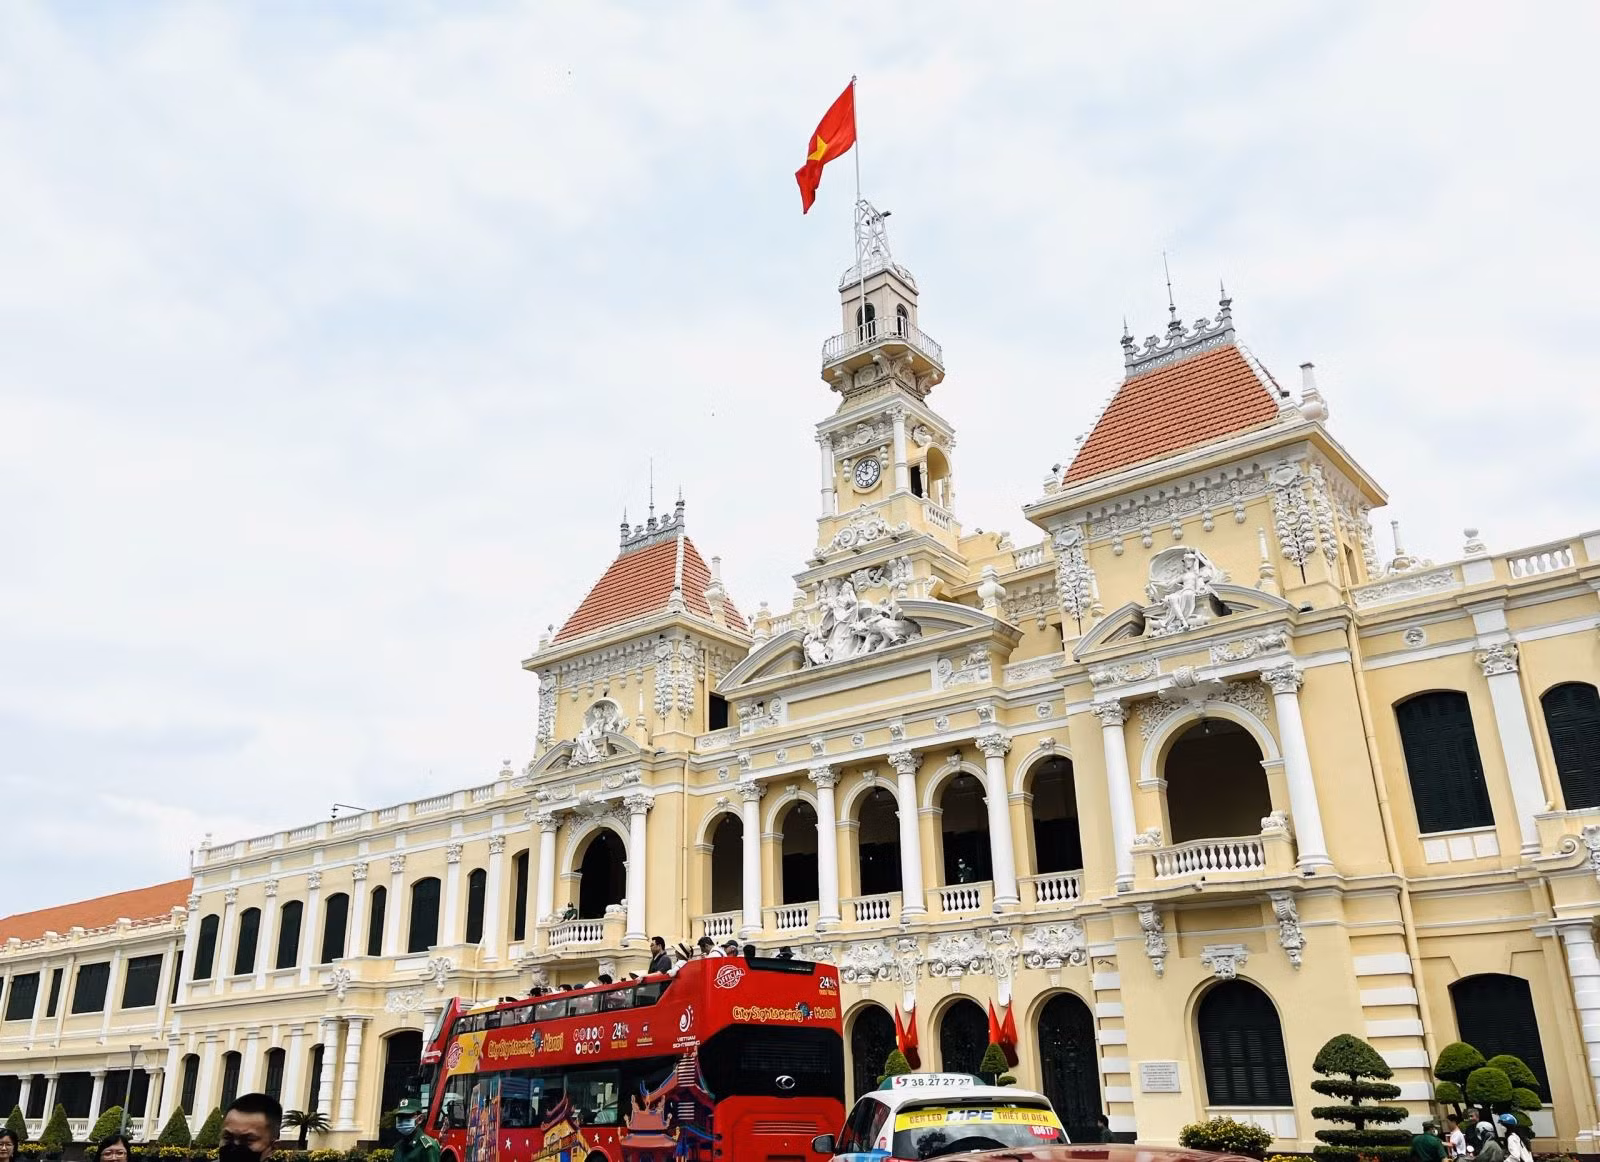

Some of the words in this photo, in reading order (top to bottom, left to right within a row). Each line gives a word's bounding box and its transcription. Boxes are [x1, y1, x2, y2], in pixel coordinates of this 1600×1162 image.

[717, 969, 742, 986] OFFICIAL
[943, 1078, 955, 1087] 27
[958, 1078, 971, 1086] 27
[927, 1113, 942, 1122] LED
